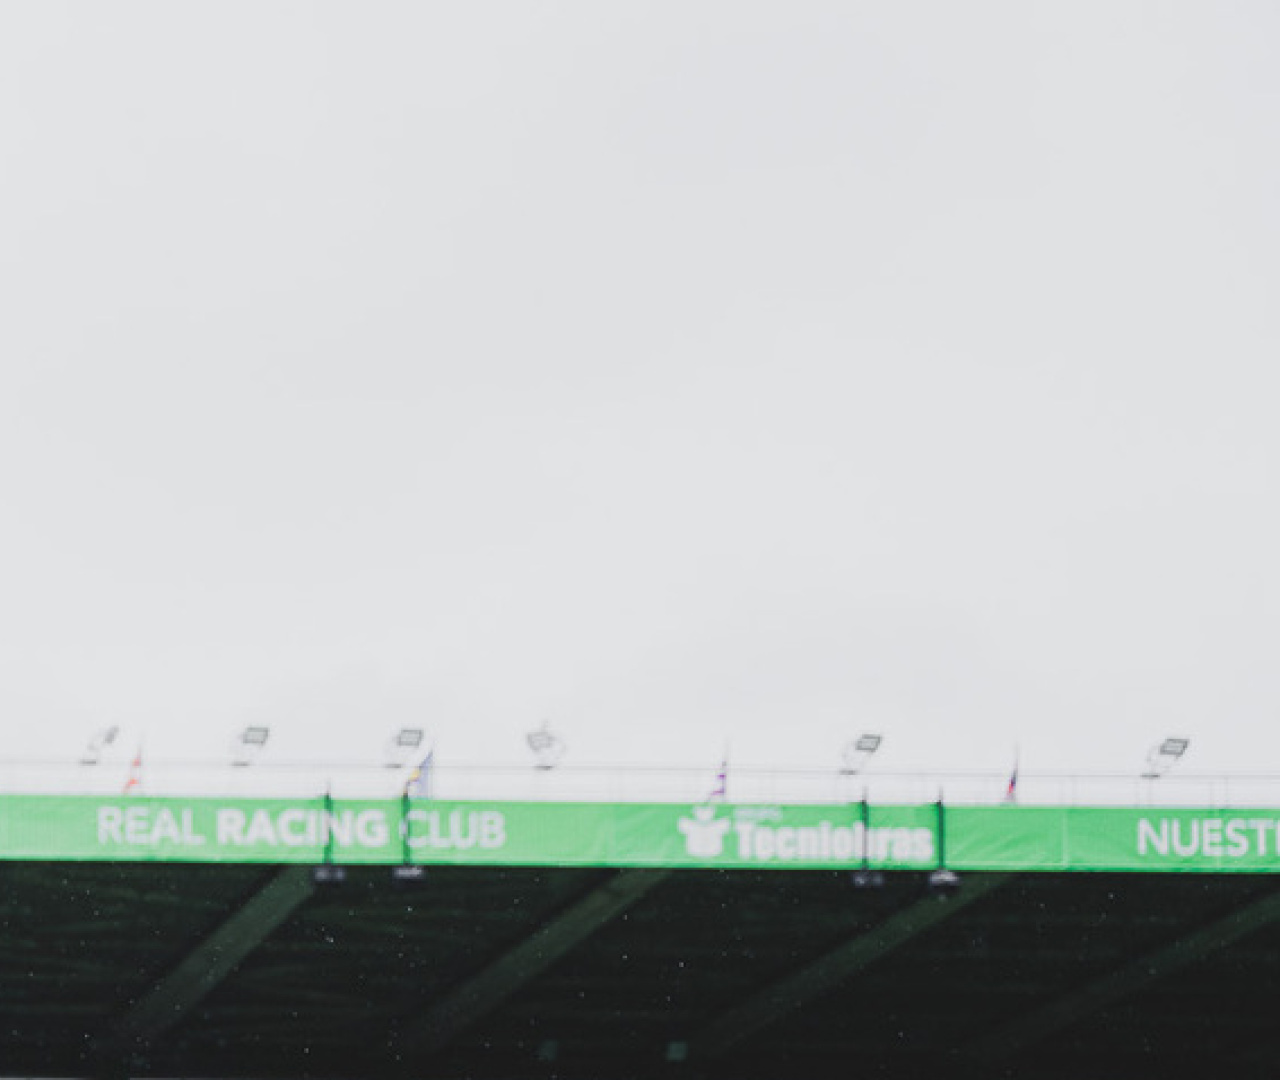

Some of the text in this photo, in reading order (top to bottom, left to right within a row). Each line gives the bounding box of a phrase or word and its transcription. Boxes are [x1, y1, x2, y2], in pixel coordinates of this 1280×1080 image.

[96, 805, 507, 850] REAL RACING CLUB
[1137, 816, 1280, 858] NUEST
